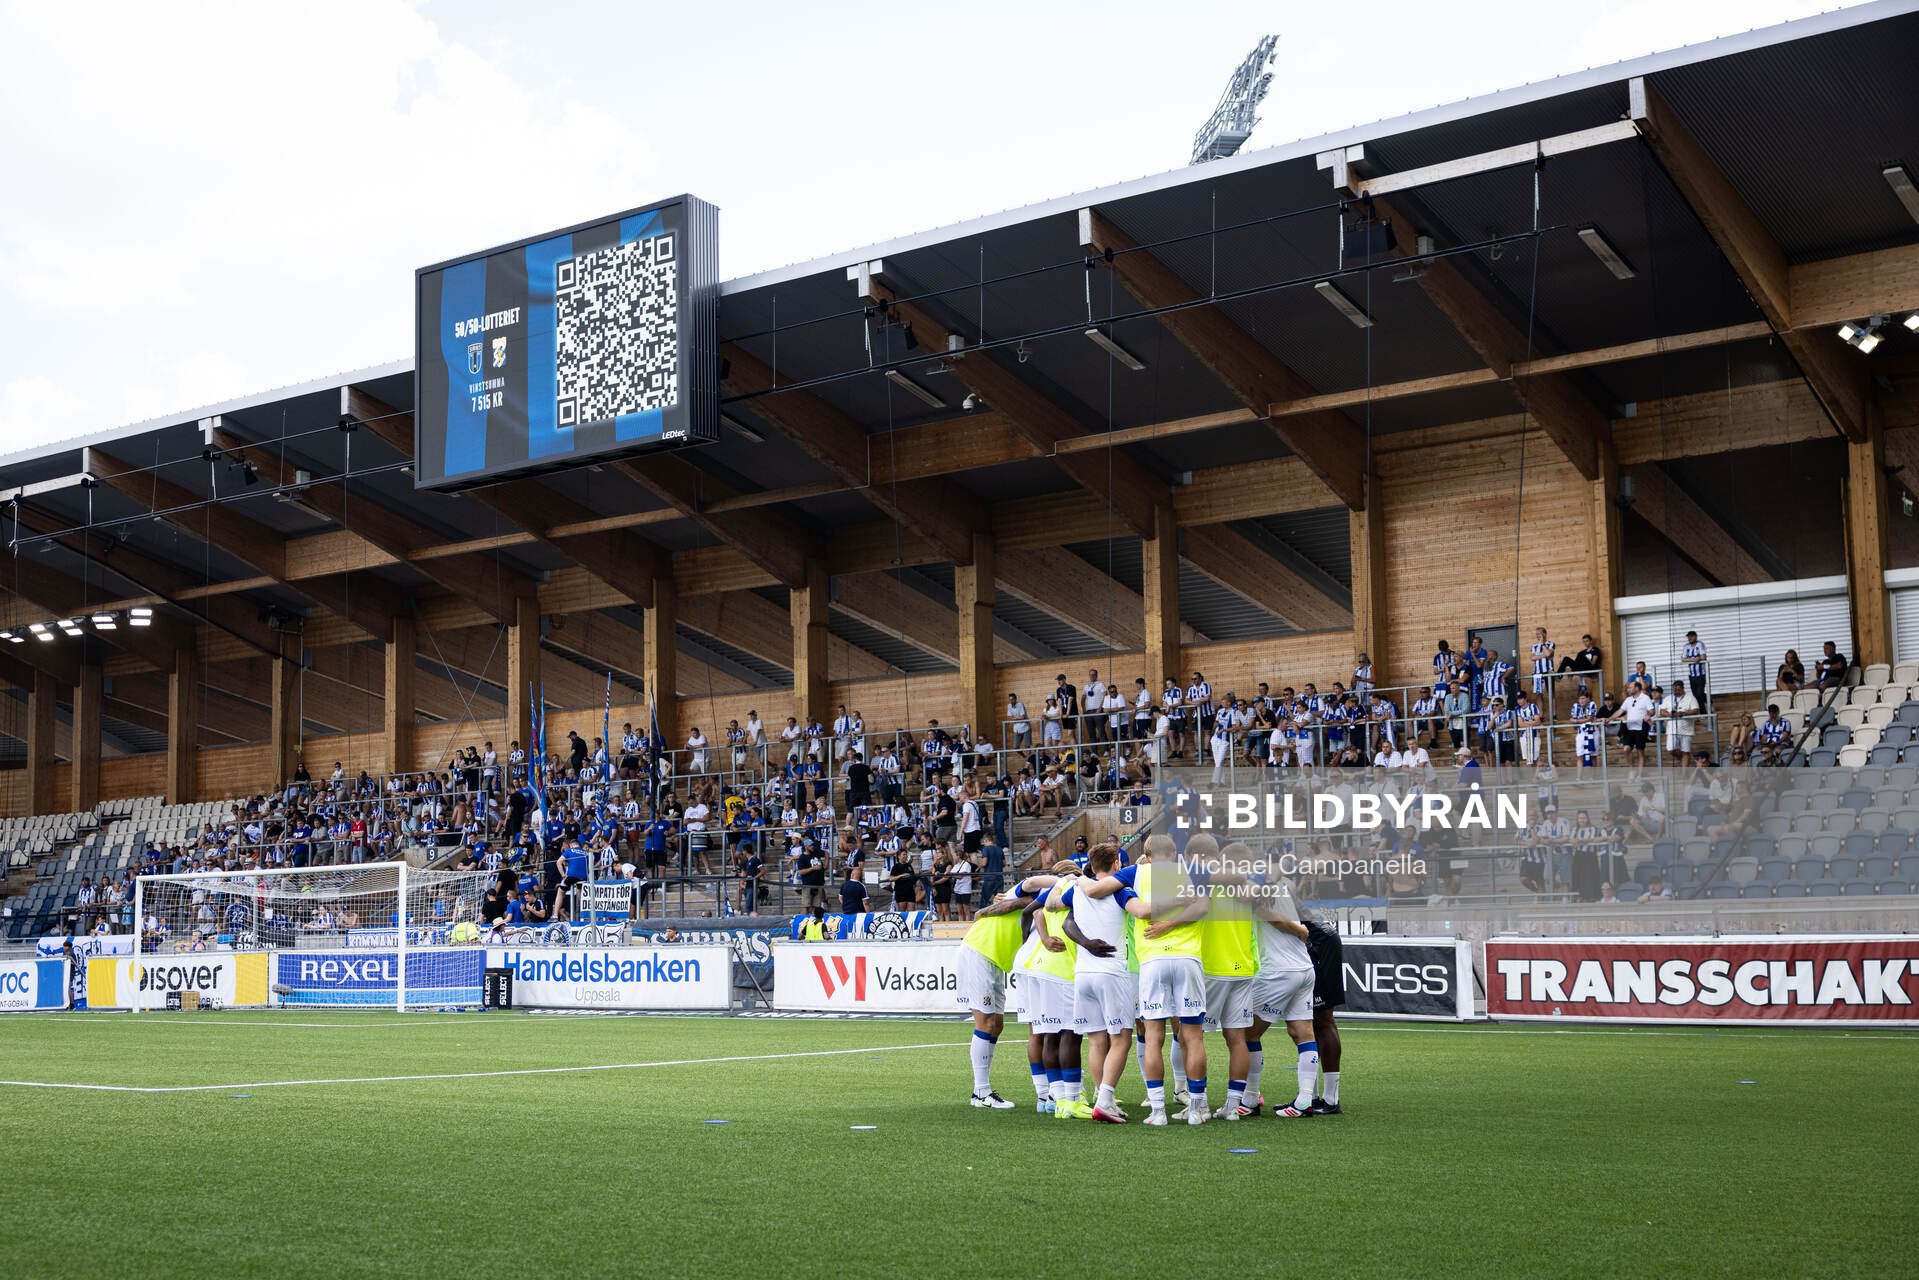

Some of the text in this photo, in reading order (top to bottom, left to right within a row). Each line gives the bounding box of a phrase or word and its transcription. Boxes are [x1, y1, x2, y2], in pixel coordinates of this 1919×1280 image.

[455, 307, 520, 338] 50/50-LOTTERIET
[469, 377, 505, 394] VINSTSUMMA
[493, 391, 503, 408] KR
[662, 430, 685, 440] LEDtec
[1124, 809, 1133, 823] 8
[429, 849, 435, 860] 9
[616, 885, 630, 898] FÖR
[232, 911, 244, 922] 22
[504, 952, 700, 983] Handelsbanken
[876, 966, 957, 990] Vaksala
[575, 987, 621, 1002] Uppsala
